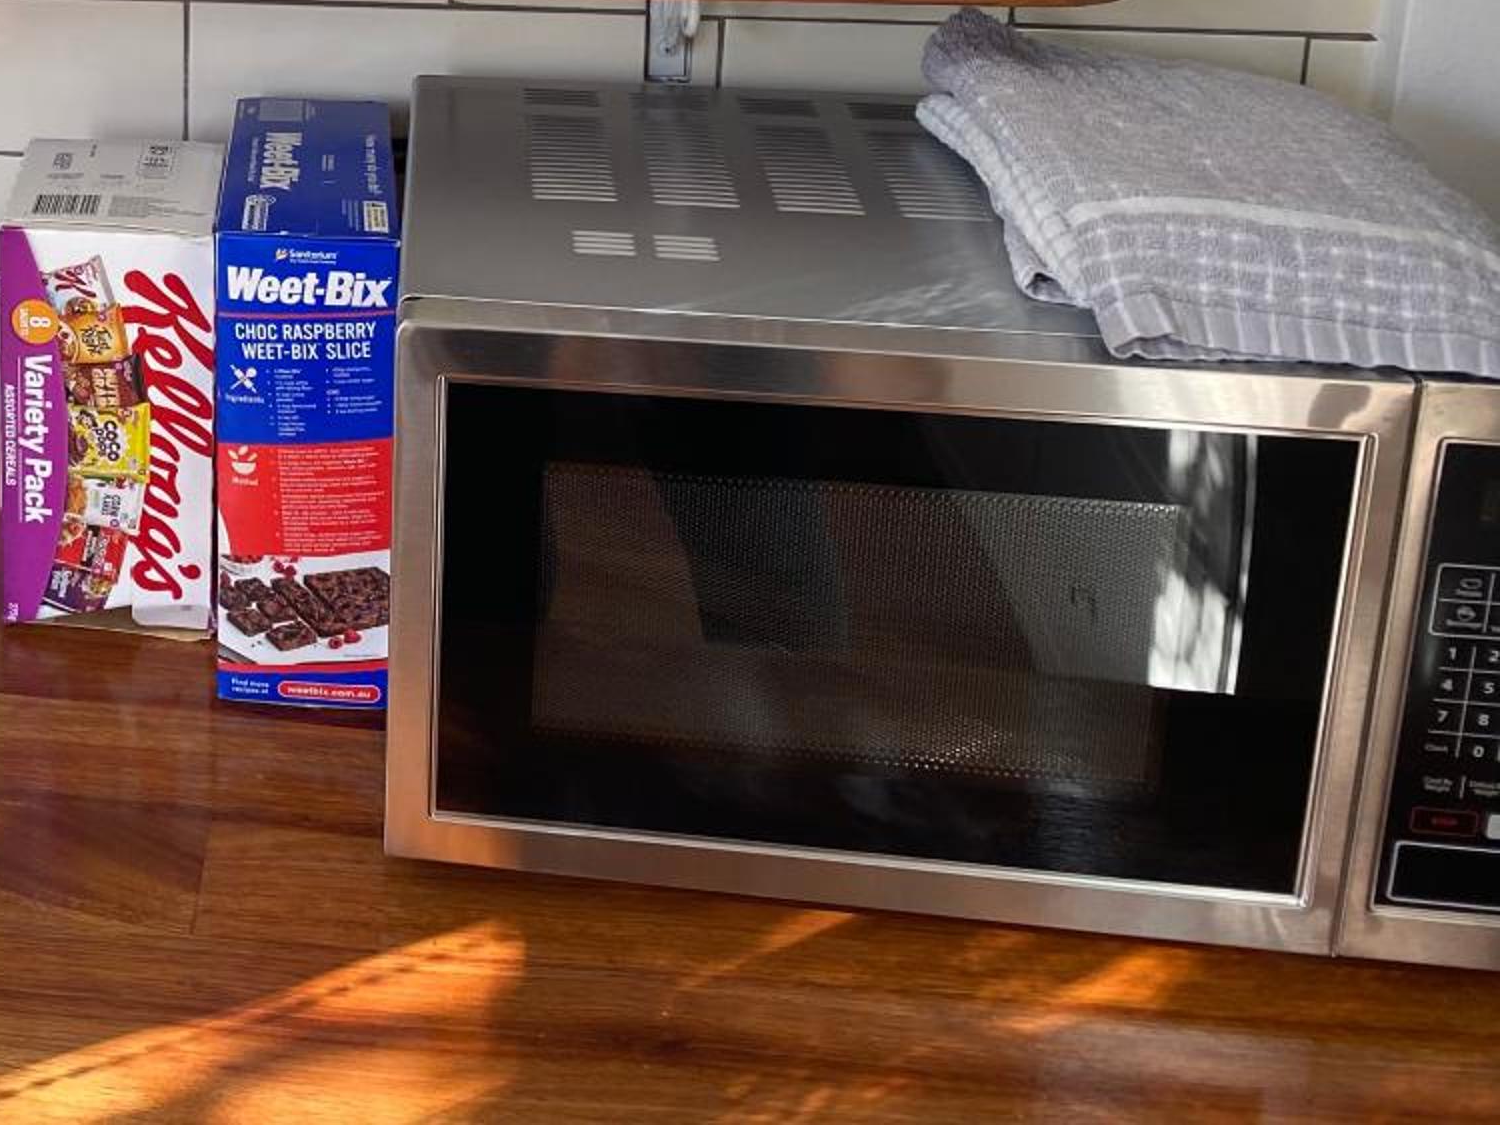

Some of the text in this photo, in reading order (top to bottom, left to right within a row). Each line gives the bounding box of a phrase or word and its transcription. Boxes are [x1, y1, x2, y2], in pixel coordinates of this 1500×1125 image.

[227, 265, 393, 308] Weet-Bix
[29, 315, 51, 328] 8
[235, 321, 376, 340] CHOC RASPBERRY
[241, 341, 371, 360] WEET-BIX SLICE
[4, 383, 17, 486] ASSORTED CEREALS
[19, 354, 52, 524] Variety Pack
[104, 420, 121, 462] COCO
[123, 269, 214, 602] Kellogg's
[1449, 647, 1500, 663] 1 2
[1440, 679, 1495, 695] 4 5
[1437, 710, 1489, 726] 7 8
[1473, 745, 1485, 758] 0
